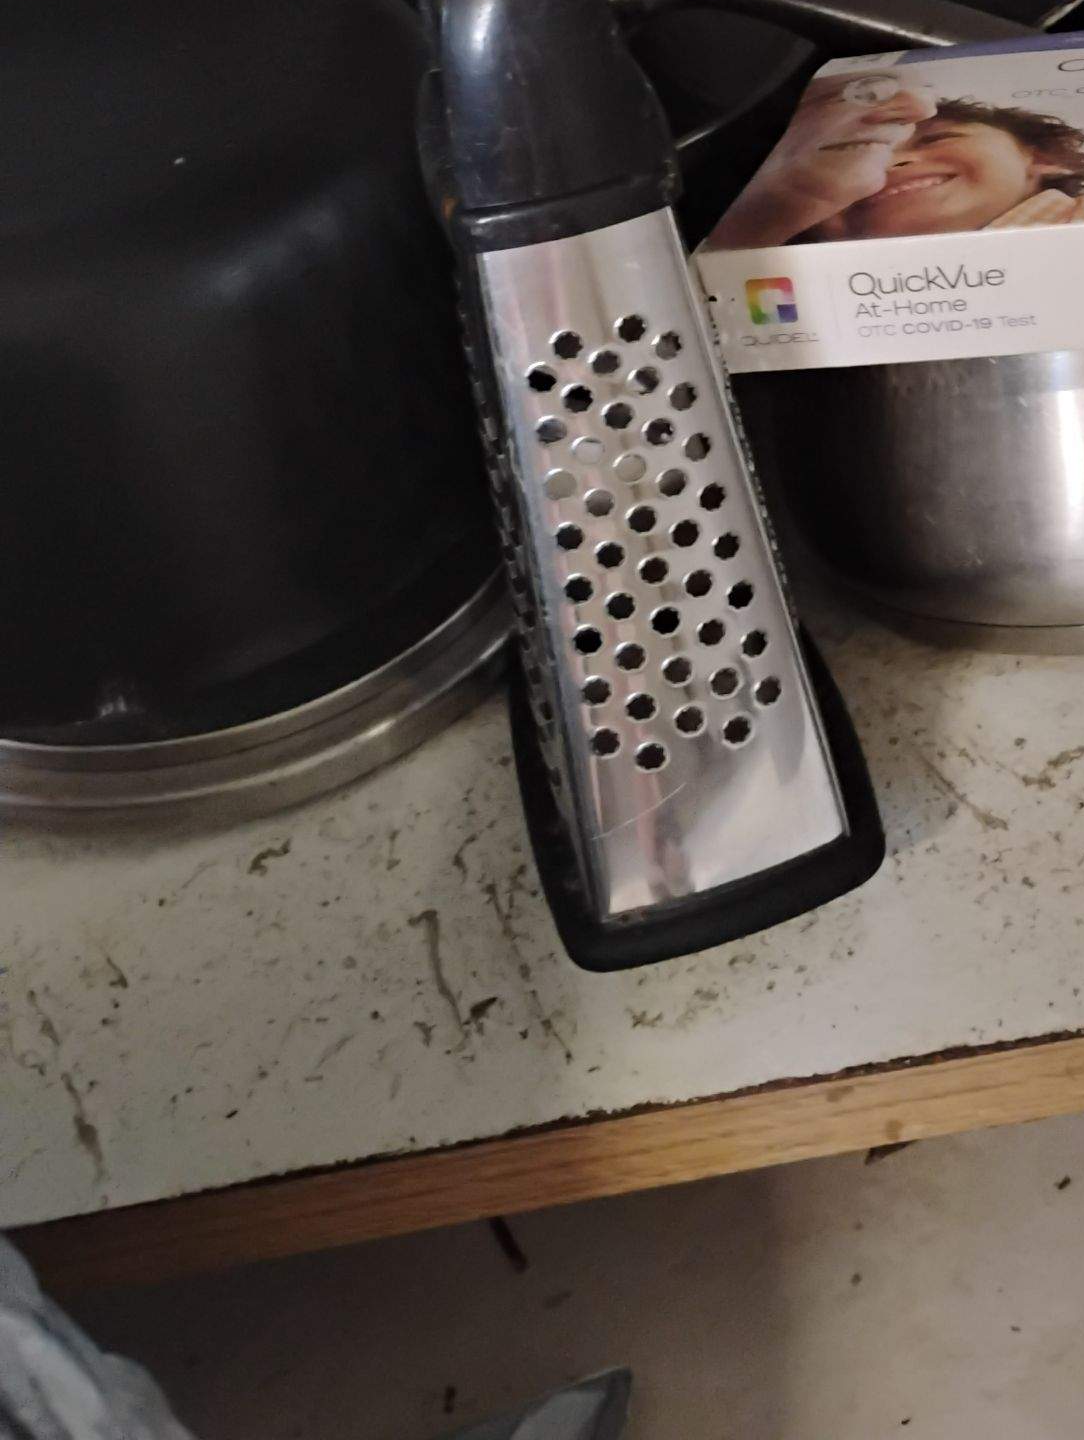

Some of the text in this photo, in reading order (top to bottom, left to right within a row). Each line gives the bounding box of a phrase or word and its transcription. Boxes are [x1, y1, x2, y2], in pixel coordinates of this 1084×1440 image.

[847, 264, 1006, 300] QuickVue
[855, 298, 968, 320] At-Home
[857, 314, 1038, 338] OTC COVID-19 Test
